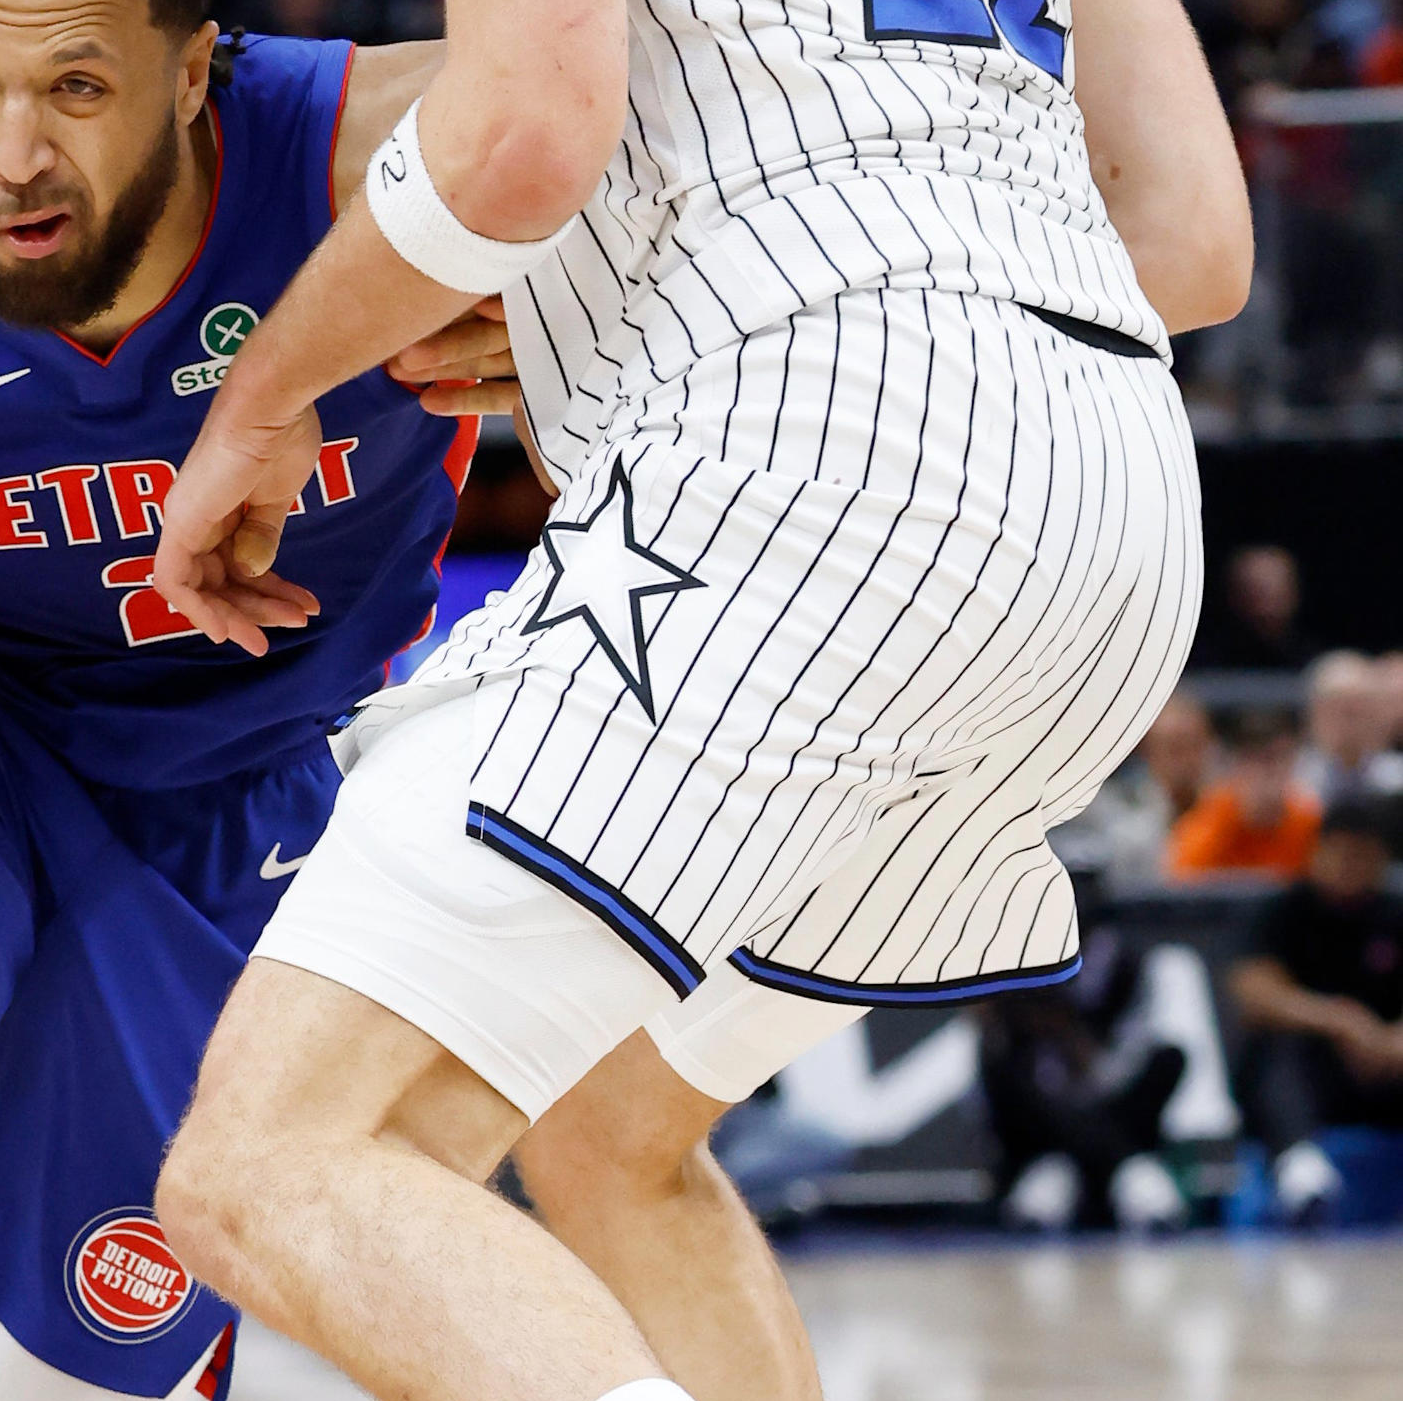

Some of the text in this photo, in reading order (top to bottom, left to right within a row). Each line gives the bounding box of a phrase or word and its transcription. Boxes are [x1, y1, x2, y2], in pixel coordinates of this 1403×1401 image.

[176, 365, 230, 391] Sto
[100, 554, 206, 648] 2
[90, 1258, 172, 1310] PISTONS
[101, 1239, 180, 1290] DETROIT
